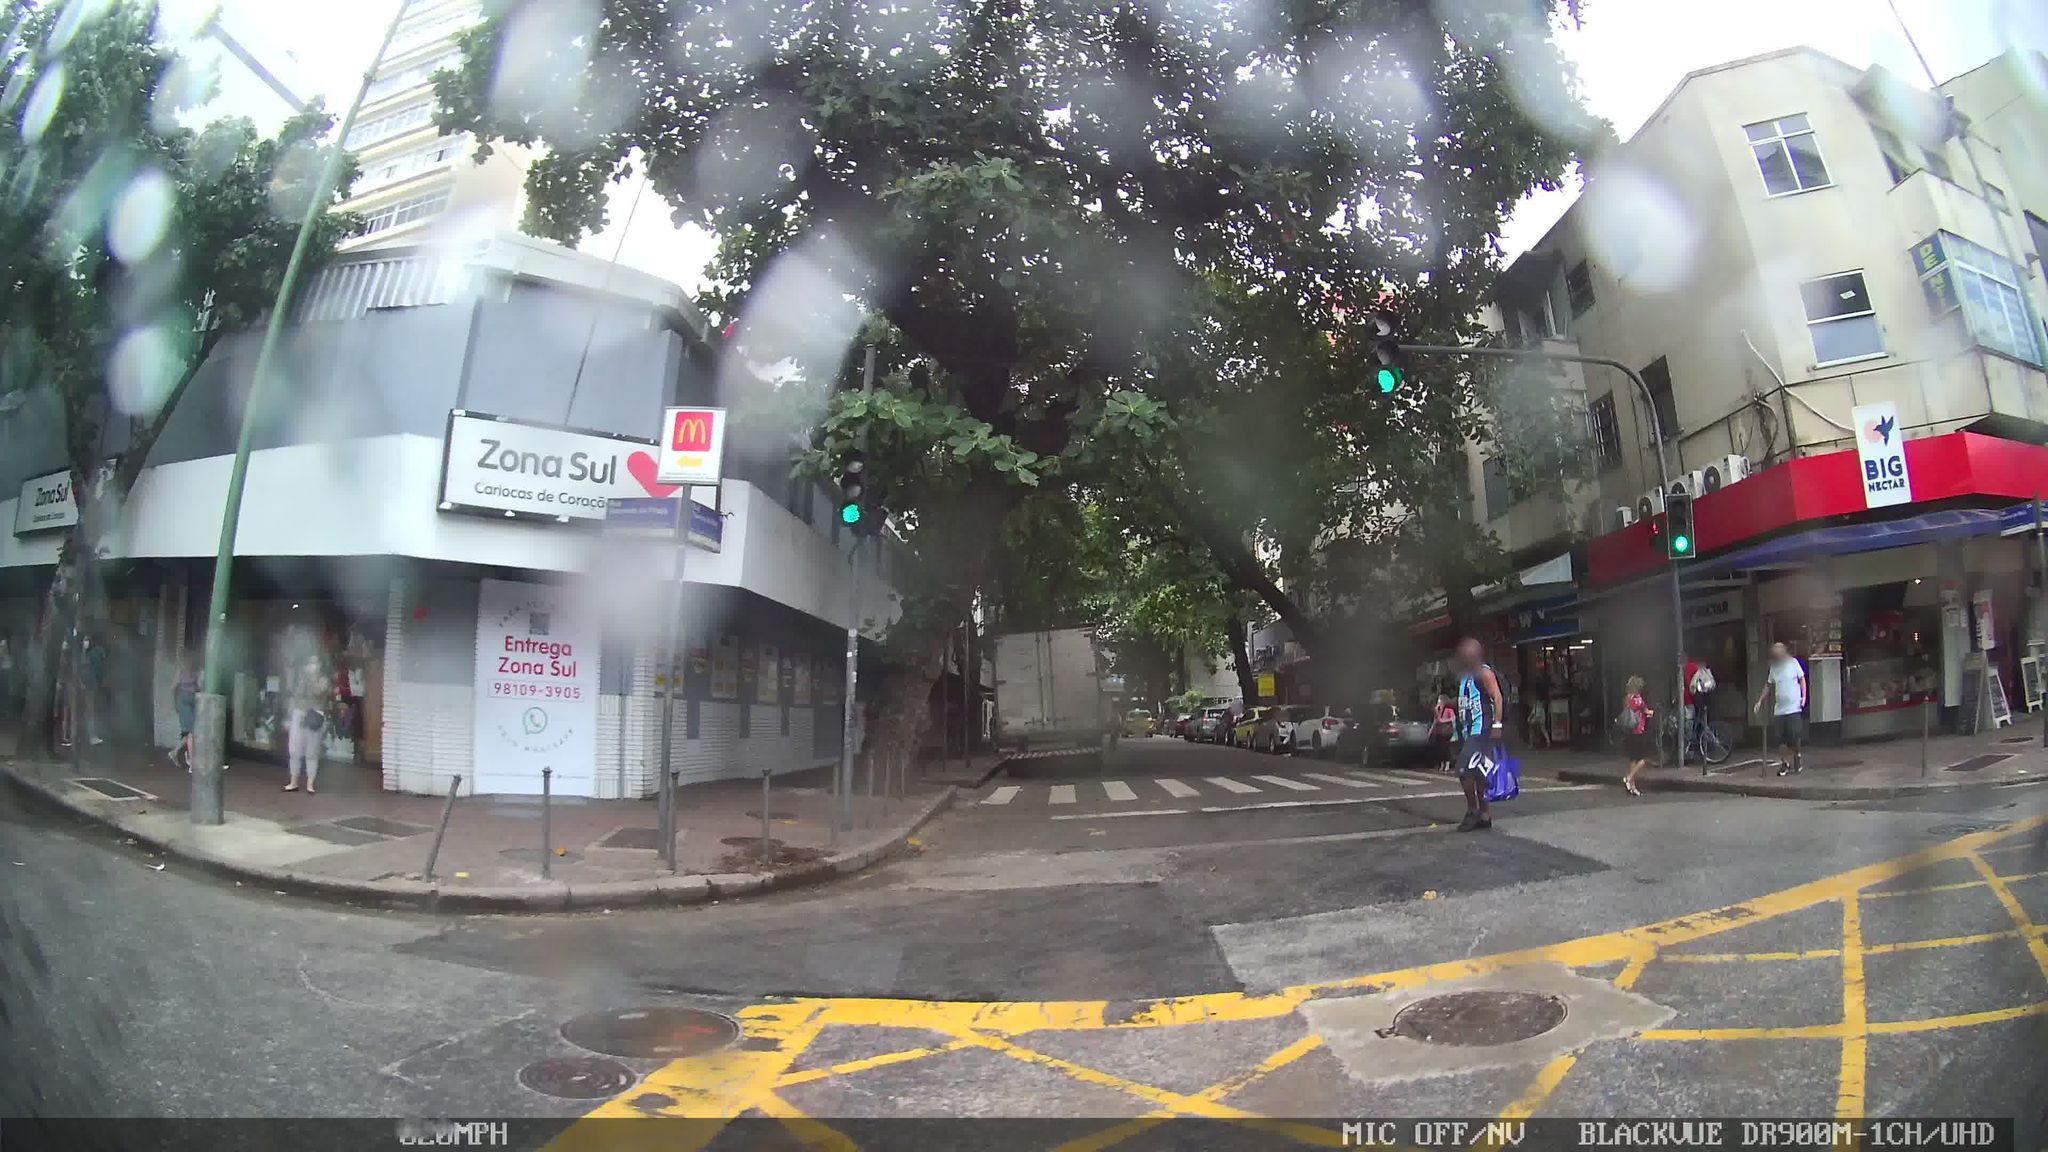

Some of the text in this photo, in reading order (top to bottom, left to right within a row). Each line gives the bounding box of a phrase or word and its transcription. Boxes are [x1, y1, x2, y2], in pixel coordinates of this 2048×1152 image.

[477, 438, 617, 486] Zona Sul
[1864, 455, 1904, 481] BIG
[537, 489, 555, 503] de
[1868, 478, 1906, 493] NECTAR
[34, 486, 56, 507] Zona
[505, 635, 573, 660] Entrega
[498, 656, 577, 677] Zona Sul
[494, 682, 581, 699] 98109-3905
